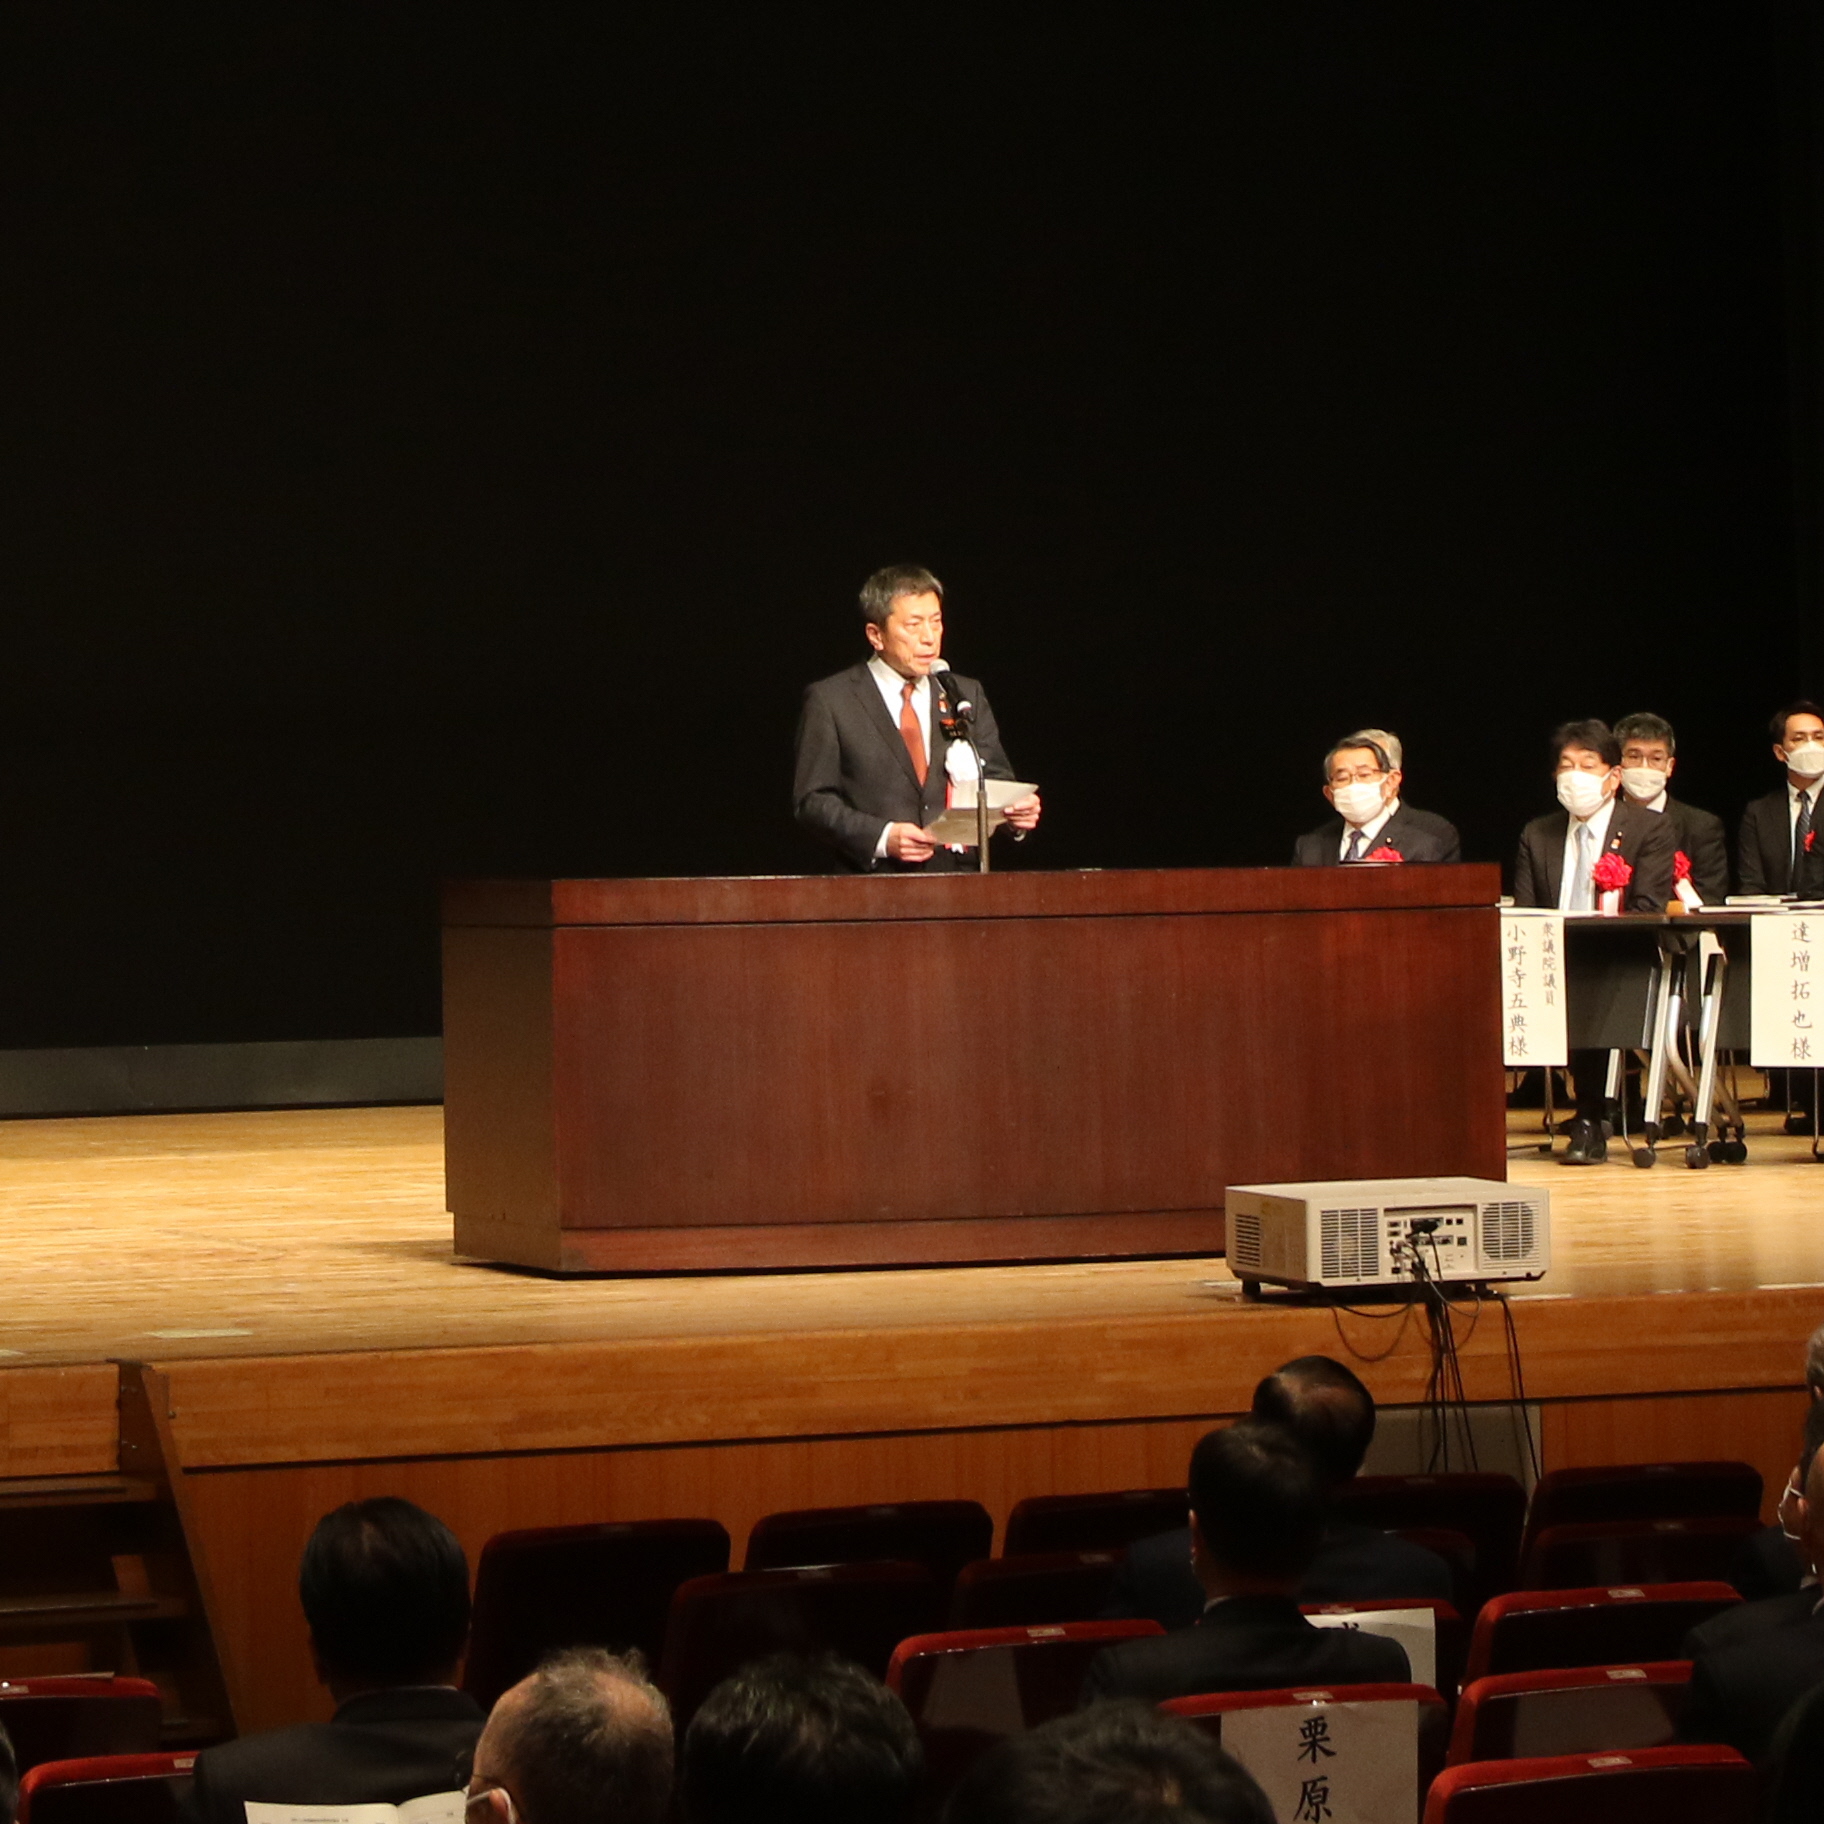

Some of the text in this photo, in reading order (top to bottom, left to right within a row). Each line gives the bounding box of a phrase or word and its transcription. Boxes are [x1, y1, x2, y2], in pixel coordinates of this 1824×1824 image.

[1507, 924, 1529, 1057] 小野寺五典様
[1542, 922, 1557, 1007] 衆議院議員
[1790, 920, 1813, 1060] 達増拓也様
[1293, 1715, 1337, 1824] 栗原
